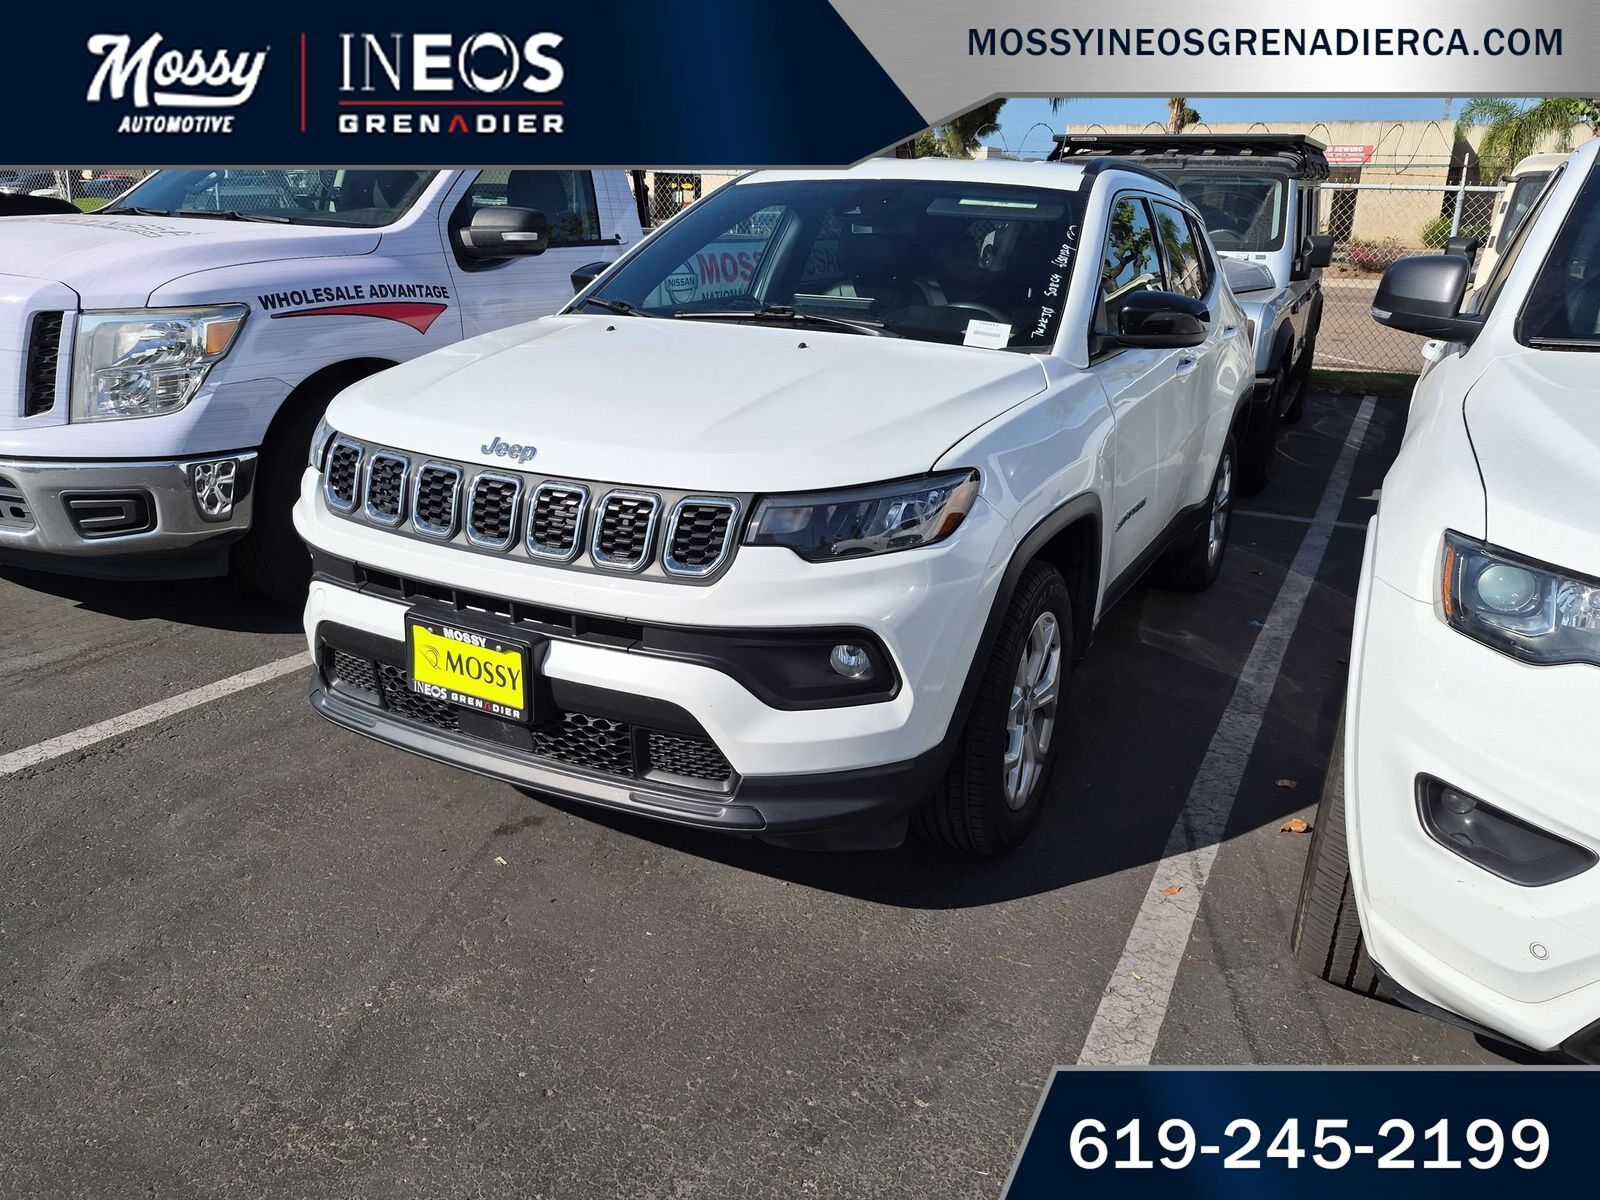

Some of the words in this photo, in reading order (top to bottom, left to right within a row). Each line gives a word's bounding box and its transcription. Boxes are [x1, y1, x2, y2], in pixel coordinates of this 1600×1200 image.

[667, 276, 696, 288] NISSAN
[257, 285, 365, 311] WHOLESALE
[369, 283, 450, 299] ADVANTAGE
[480, 436, 537, 464] Jeep
[443, 627, 487, 648] MOSSY
[445, 650, 521, 692] MOSSY
[413, 680, 448, 700] INEOS
[451, 692, 521, 719] GRENADIER
